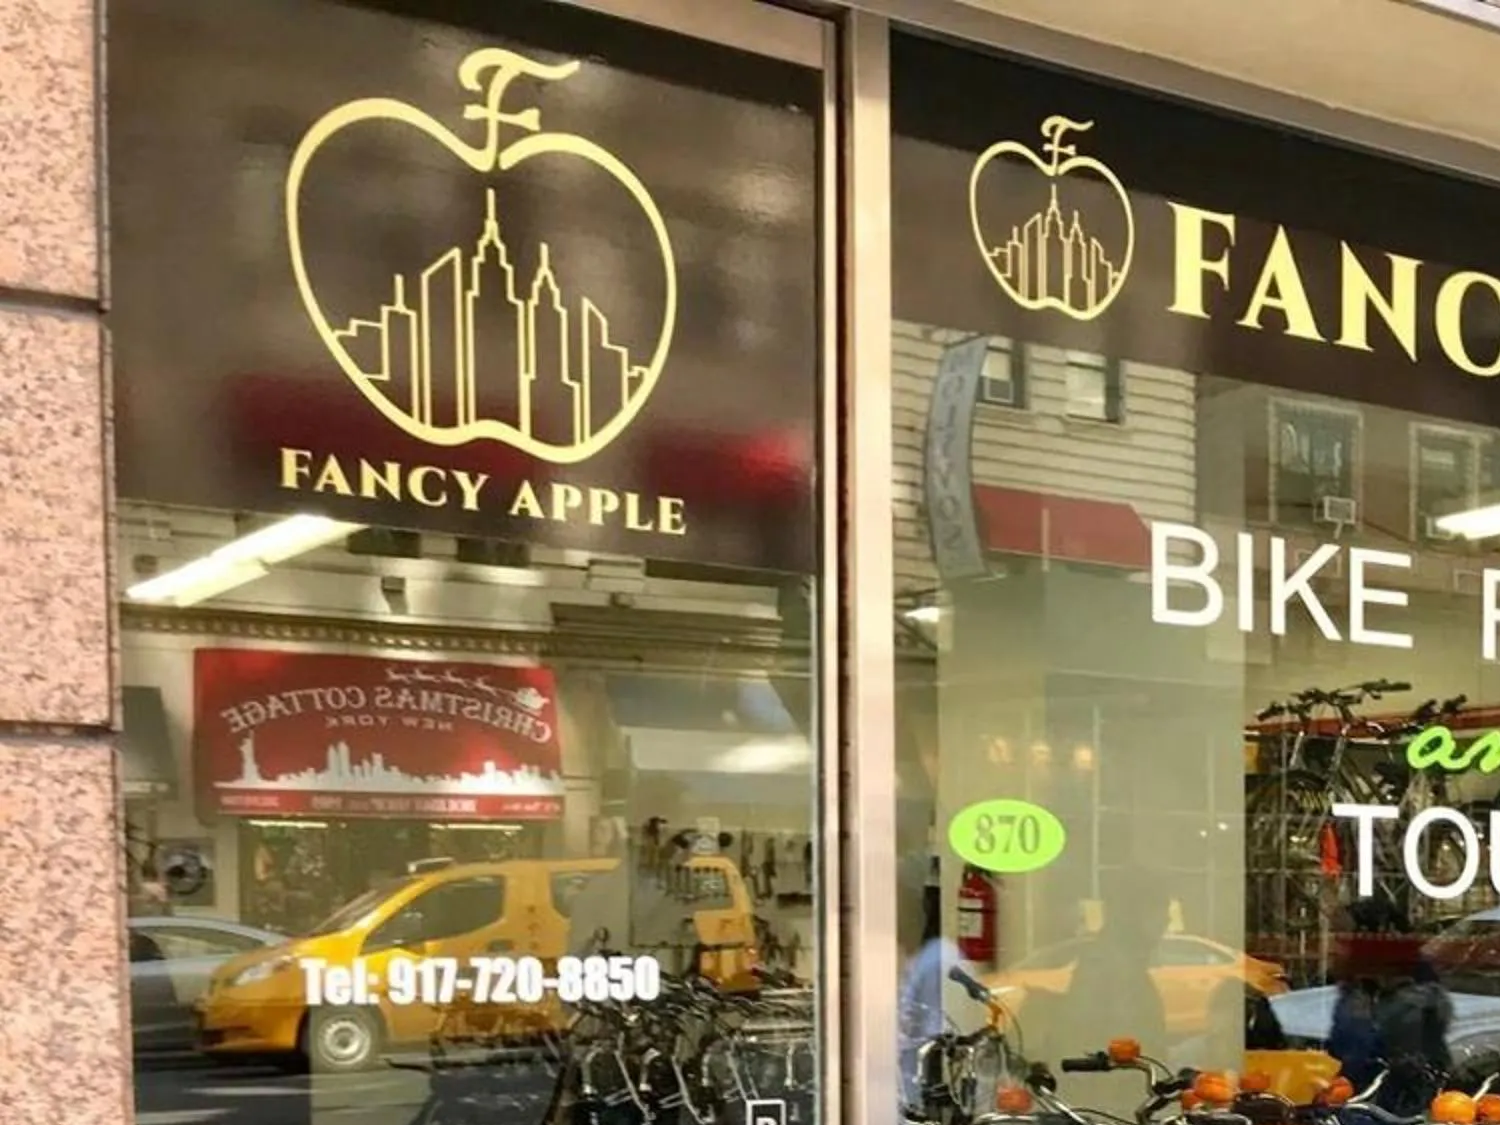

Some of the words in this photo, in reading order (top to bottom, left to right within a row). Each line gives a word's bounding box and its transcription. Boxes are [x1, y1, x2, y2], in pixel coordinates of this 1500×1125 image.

[280, 447, 489, 512] FANCY
[511, 479, 687, 536] APPLE
[1148, 522, 1413, 650] BIKE
[973, 813, 1041, 855] 870
[301, 957, 379, 1006] Tel:
[388, 955, 660, 1006] 917-720-8850
